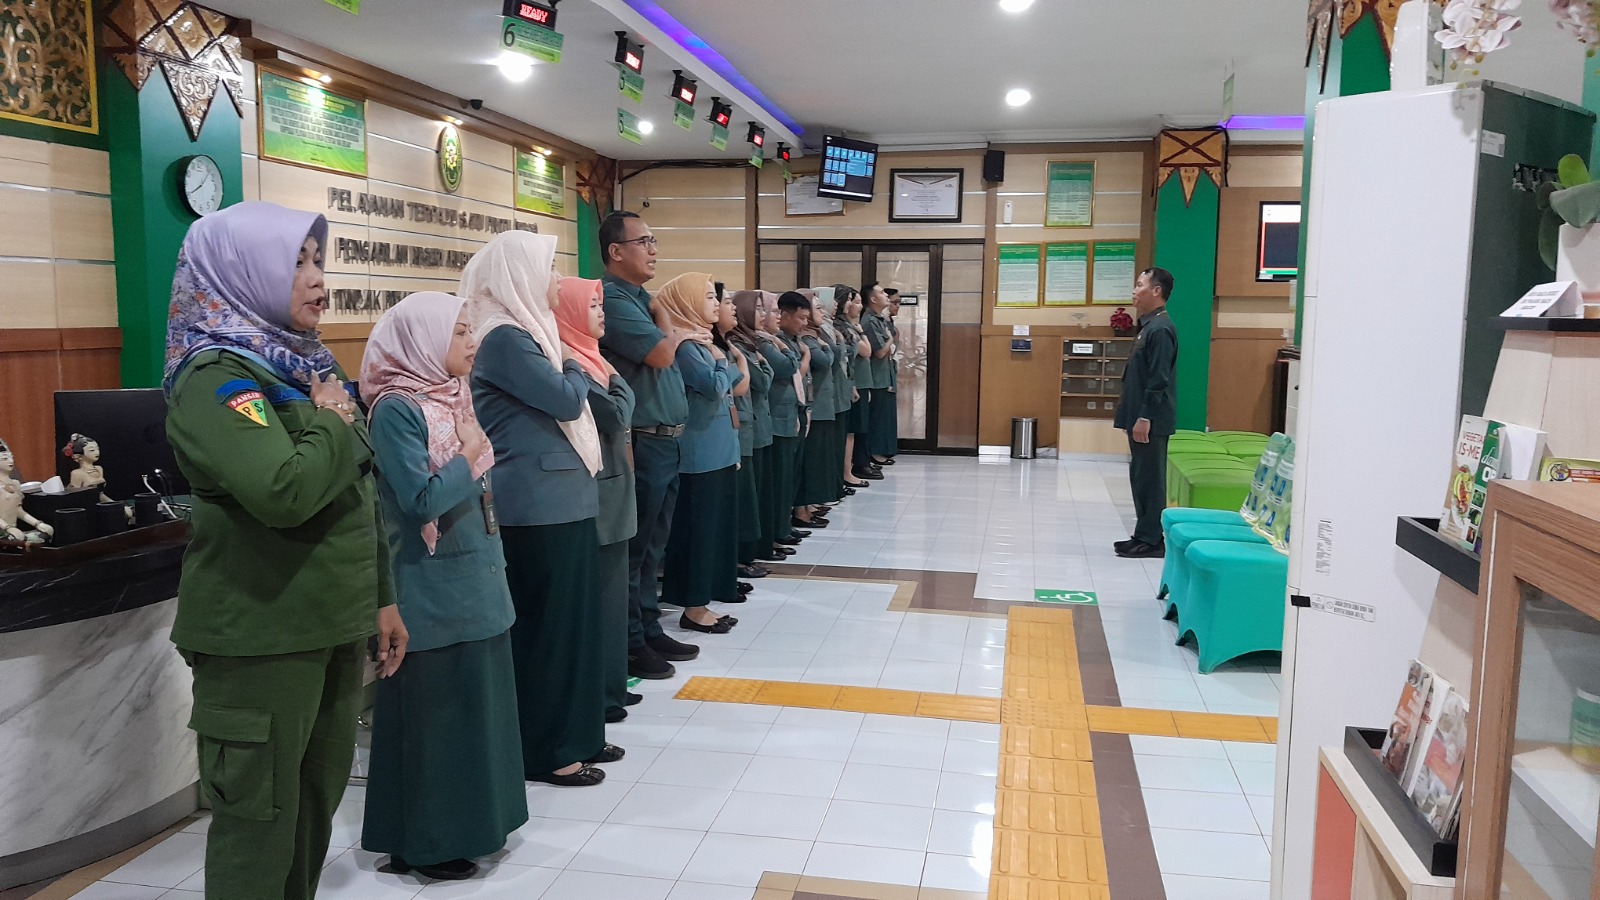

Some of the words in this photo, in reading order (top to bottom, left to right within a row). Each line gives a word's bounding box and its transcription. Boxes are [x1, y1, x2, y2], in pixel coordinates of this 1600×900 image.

[519, 3, 549, 23] READY
[503, 22, 516, 48] 6
[327, 186, 405, 220] PELAYANAN
[242, 406, 252, 416] P
[254, 402, 263, 413] S
